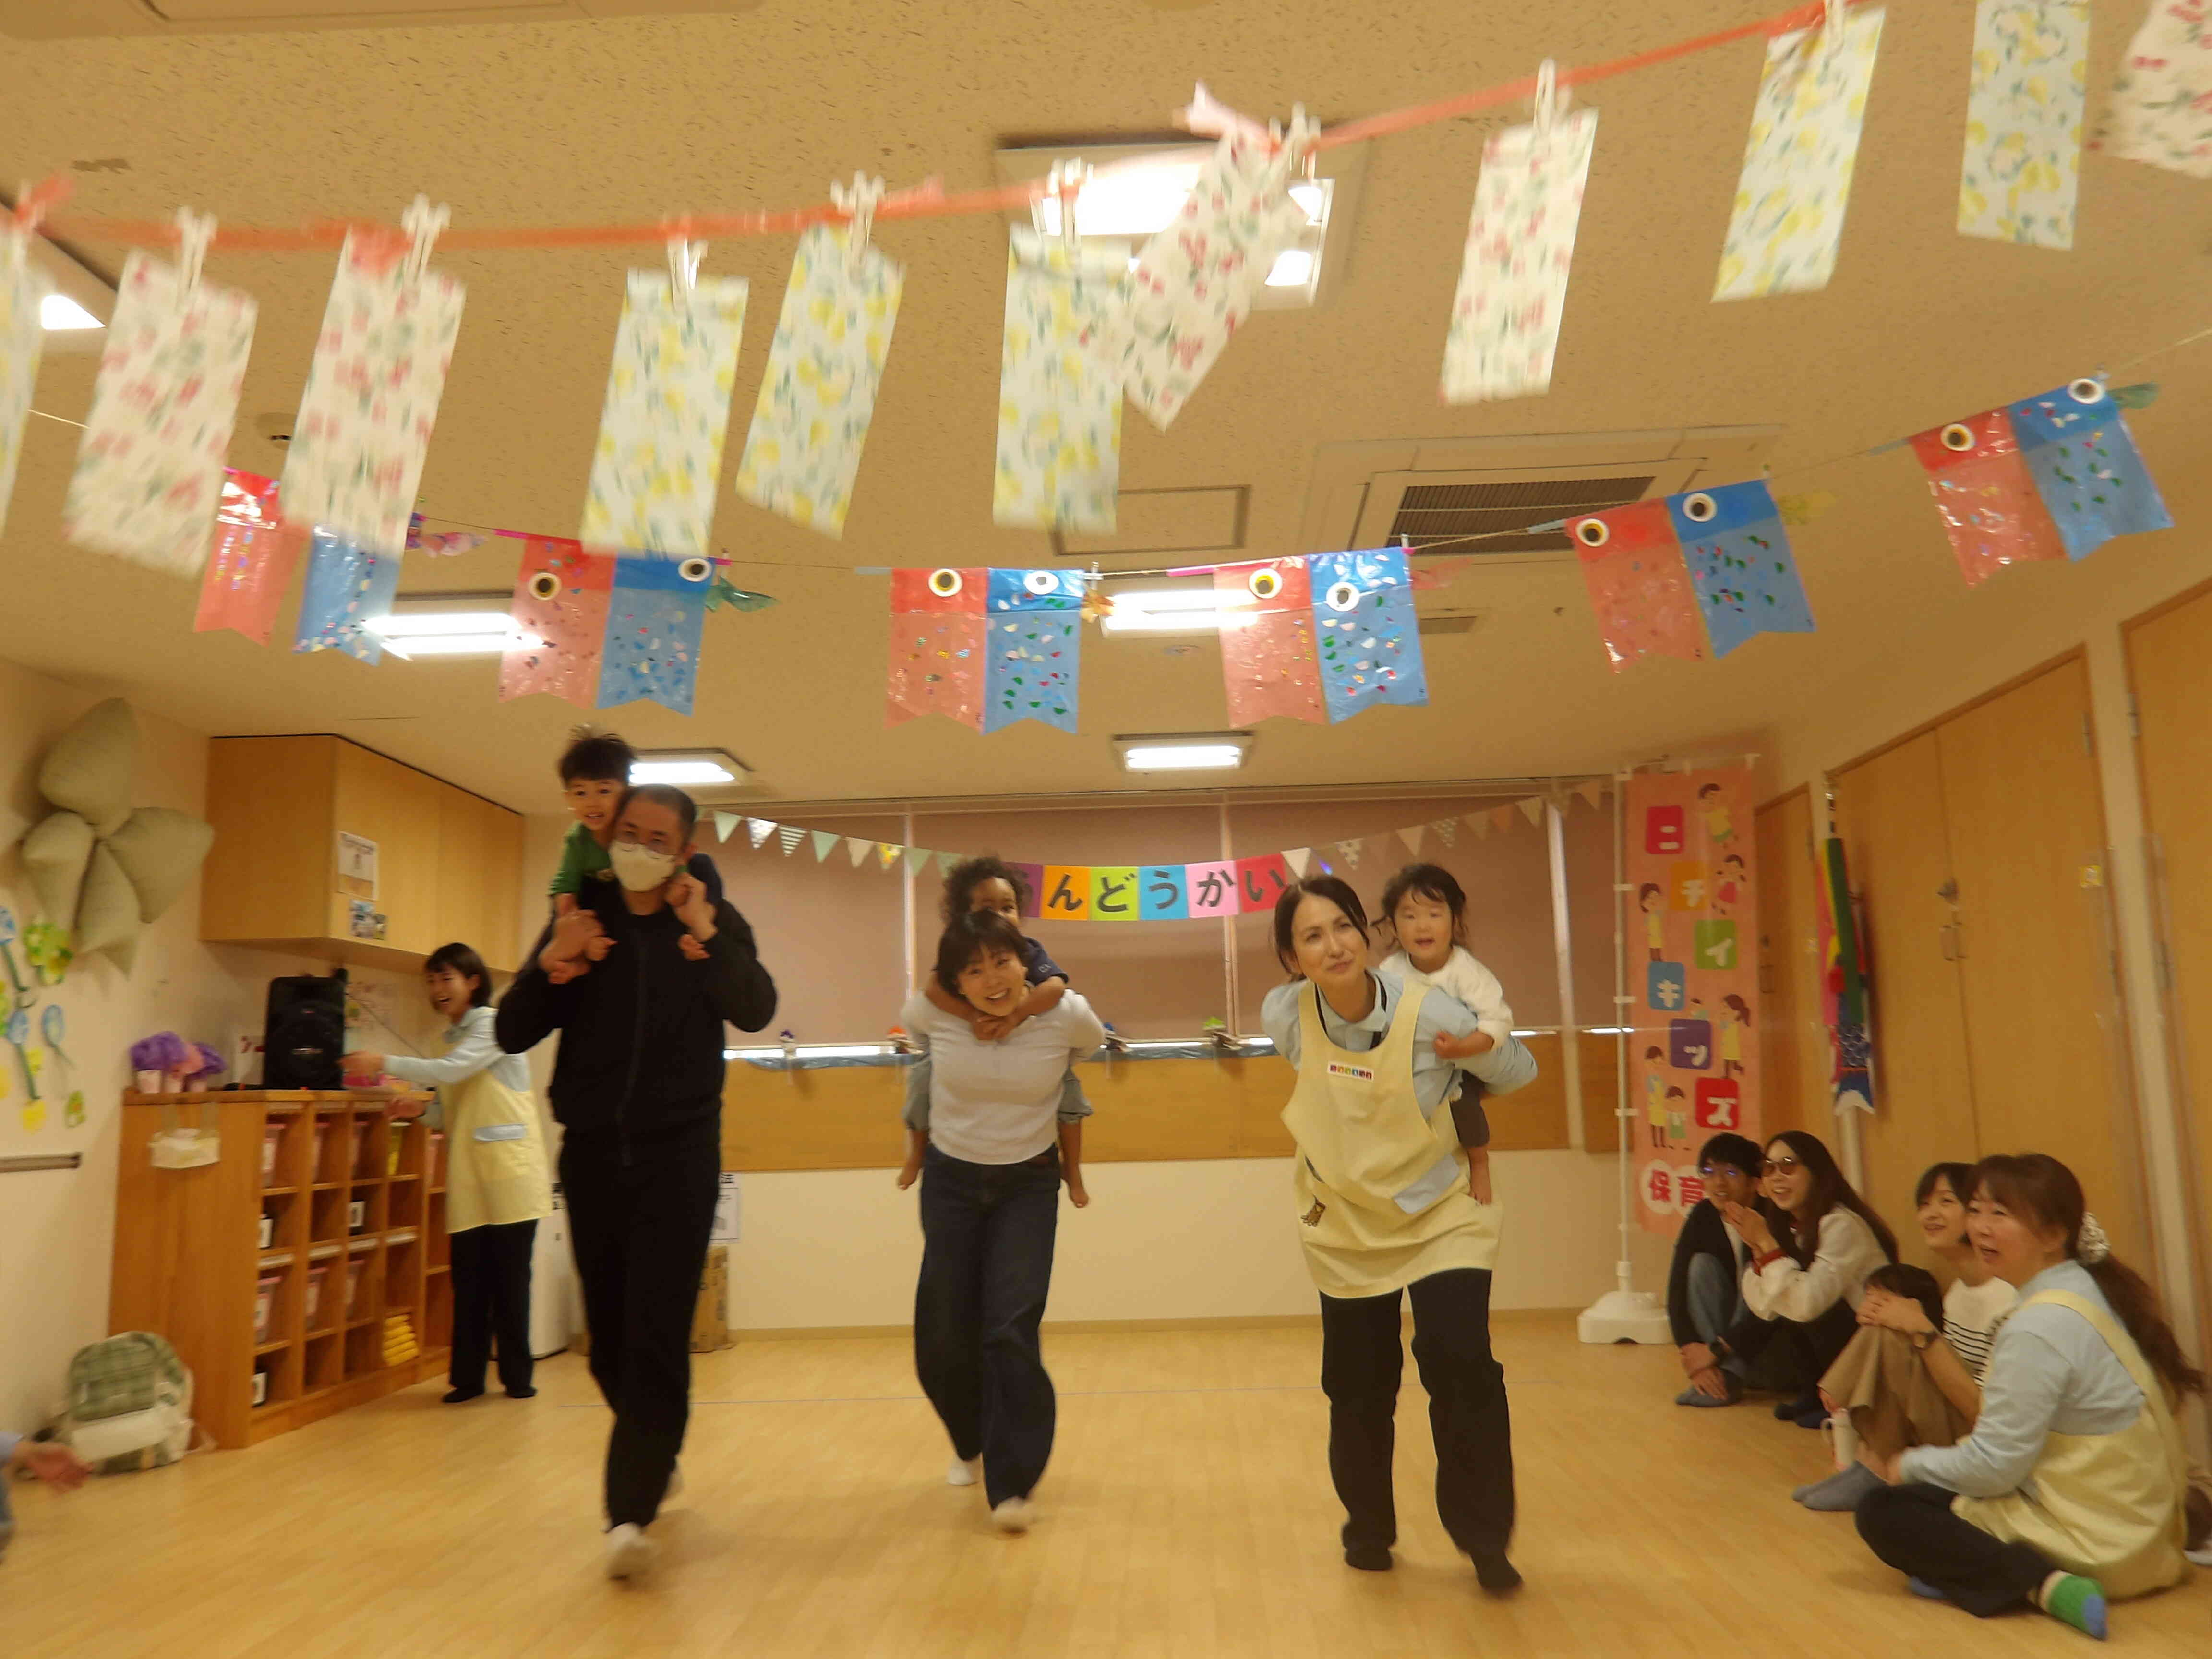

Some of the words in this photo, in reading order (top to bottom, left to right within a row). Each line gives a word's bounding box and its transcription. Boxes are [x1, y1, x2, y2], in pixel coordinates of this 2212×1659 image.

[1022, 868, 1287, 913] んどうかい
